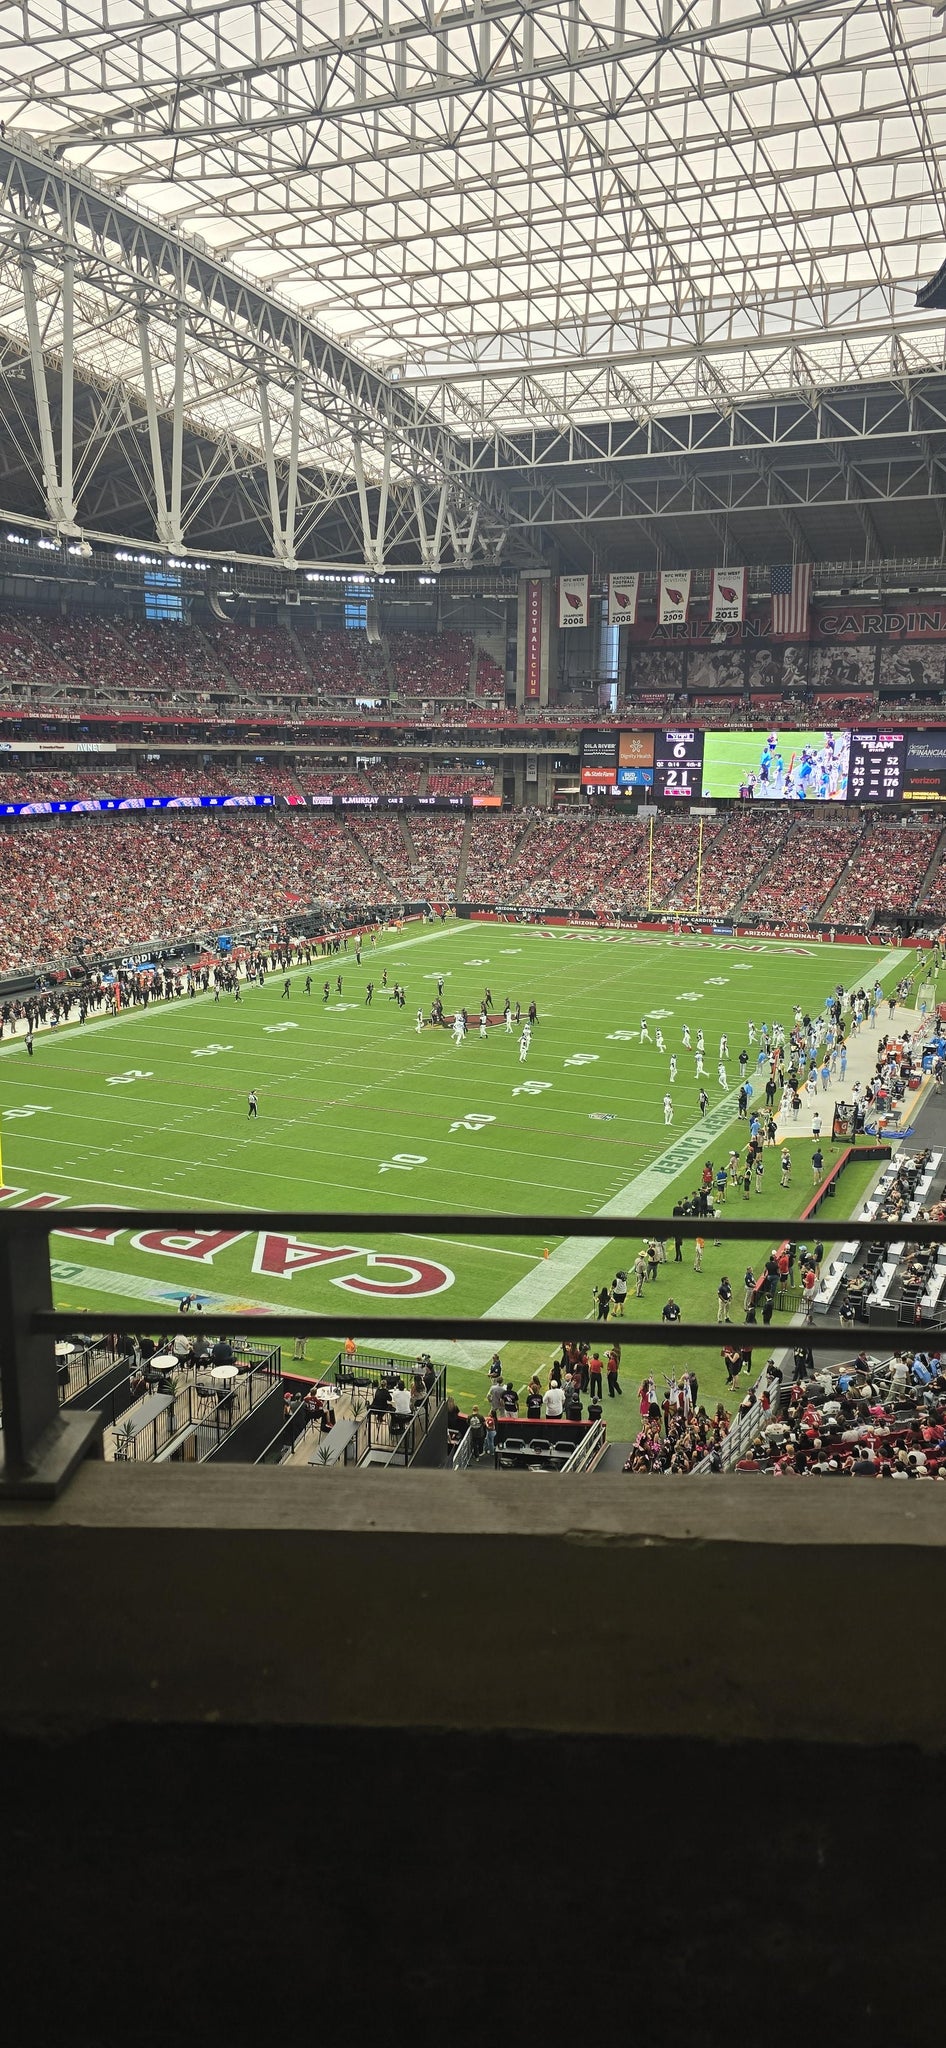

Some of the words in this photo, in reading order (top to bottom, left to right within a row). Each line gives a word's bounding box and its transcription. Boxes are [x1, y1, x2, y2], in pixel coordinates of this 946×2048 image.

[612, 615, 631, 623] 2008
[716, 611, 738, 619] 2015
[673, 742, 686, 758] 6
[855, 757, 865, 765] 51
[886, 757, 899, 765] 52
[853, 768, 865, 776] 42
[884, 768, 900, 776] 124
[666, 770, 688, 786] 21
[852, 778, 865, 786] 93
[883, 778, 899, 787] 176
[587, 785, 606, 795] 0:14
[854, 789, 861, 797] 7
[886, 789, 894, 797] 11
[513, 930, 818, 956] ARIZONA
[606, 1030, 640, 1041] 50
[191, 1043, 234, 1057] 30
[566, 1053, 601, 1067] 40
[105, 1069, 154, 1085] 20
[512, 1080, 553, 1096] 30
[2, 1104, 53, 1119] 10
[450, 1113, 497, 1132] 20
[650, 1136, 708, 1175] CANCER
[378, 1154, 429, 1172] 10
